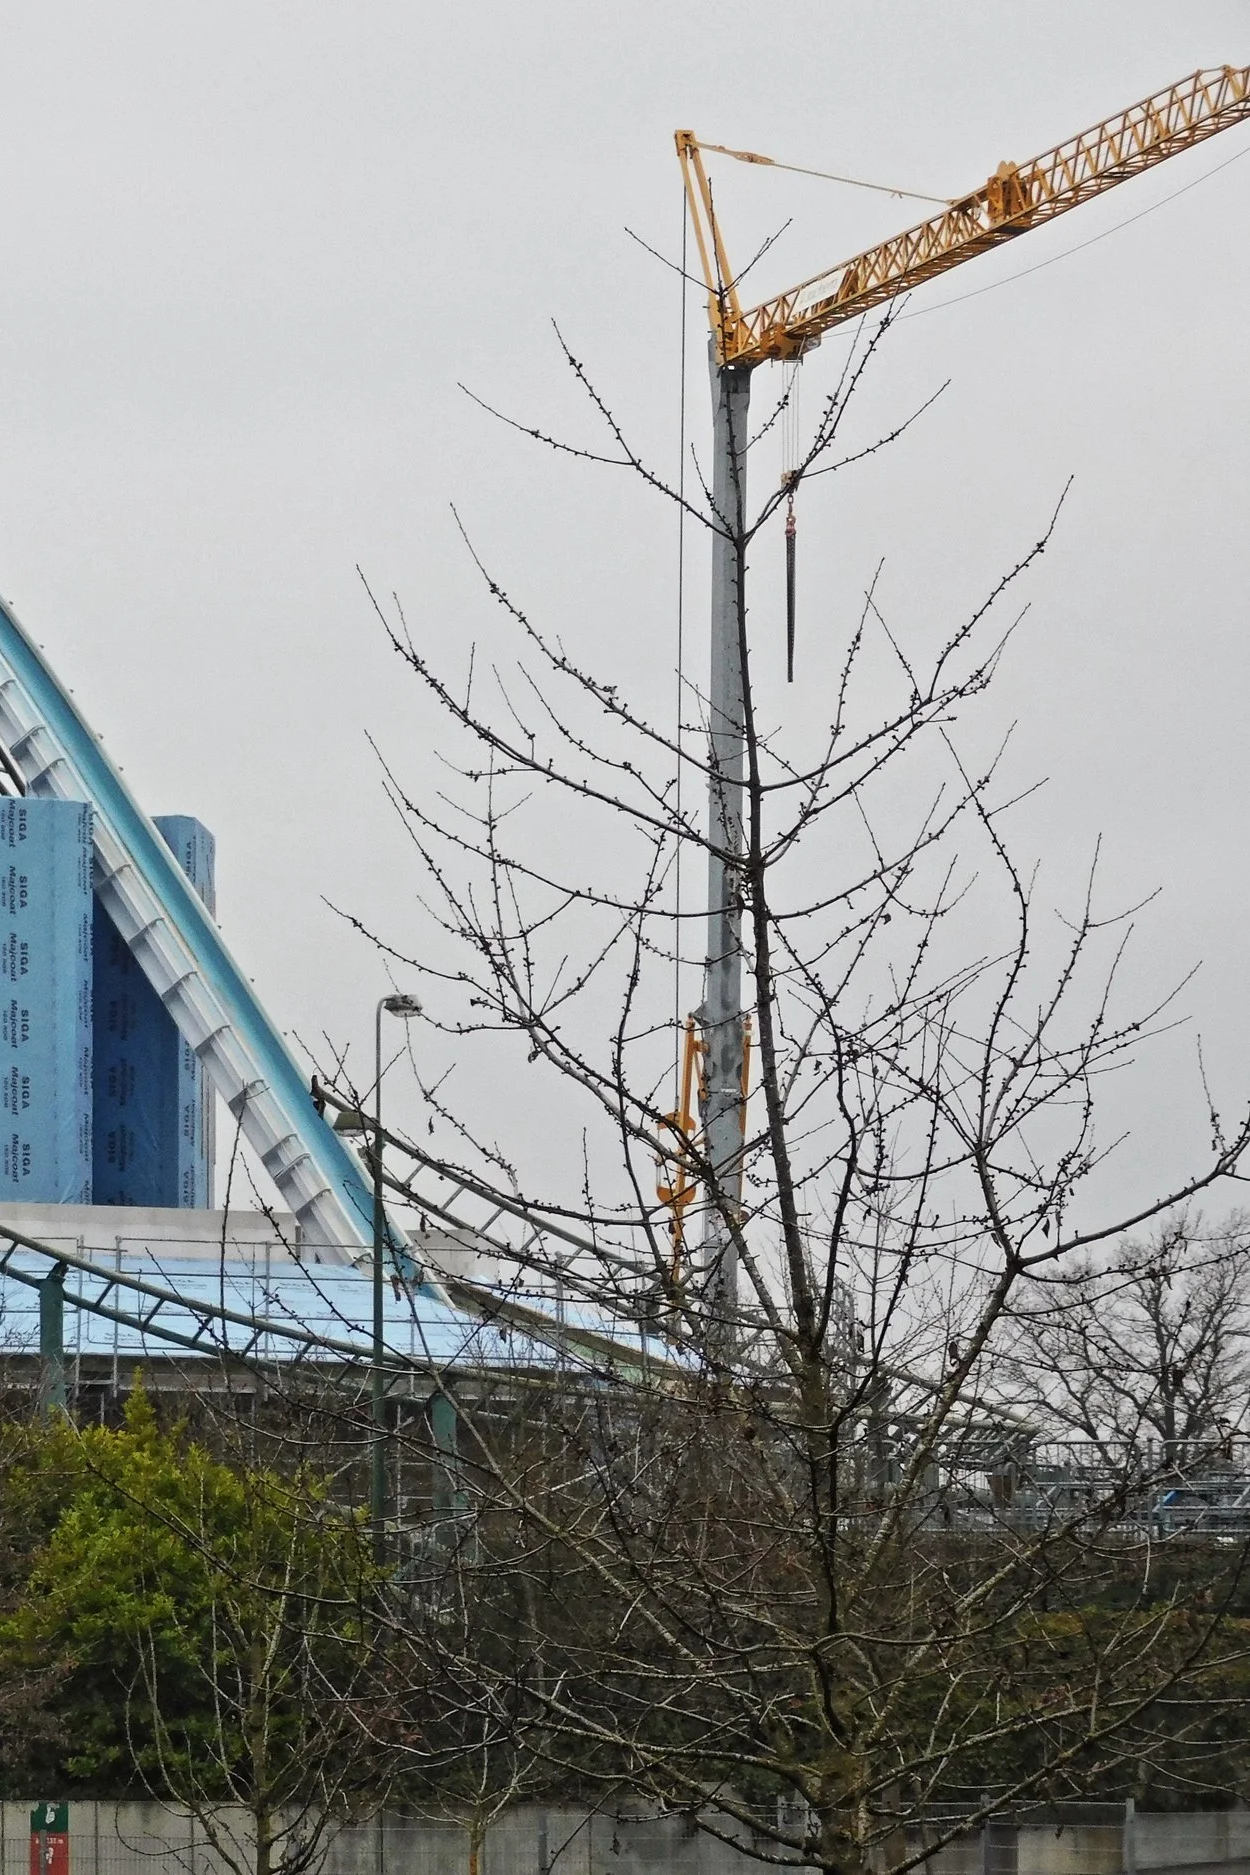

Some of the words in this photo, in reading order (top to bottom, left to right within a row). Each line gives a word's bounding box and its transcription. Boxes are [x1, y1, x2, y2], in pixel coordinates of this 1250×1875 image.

[8, 866, 16, 914] Majcoat
[19, 876, 27, 908] SIGA
[9, 933, 17, 981] Majcoat
[20, 943, 28, 975] SIGA
[10, 1000, 18, 1048] Majcoat
[21, 1010, 29, 1042] SIGA
[10, 1067, 18, 1115] Majcoat
[22, 1077, 30, 1108] SIGA
[11, 1134, 19, 1182] Majcoat
[22, 1144, 30, 1176] SIGA
